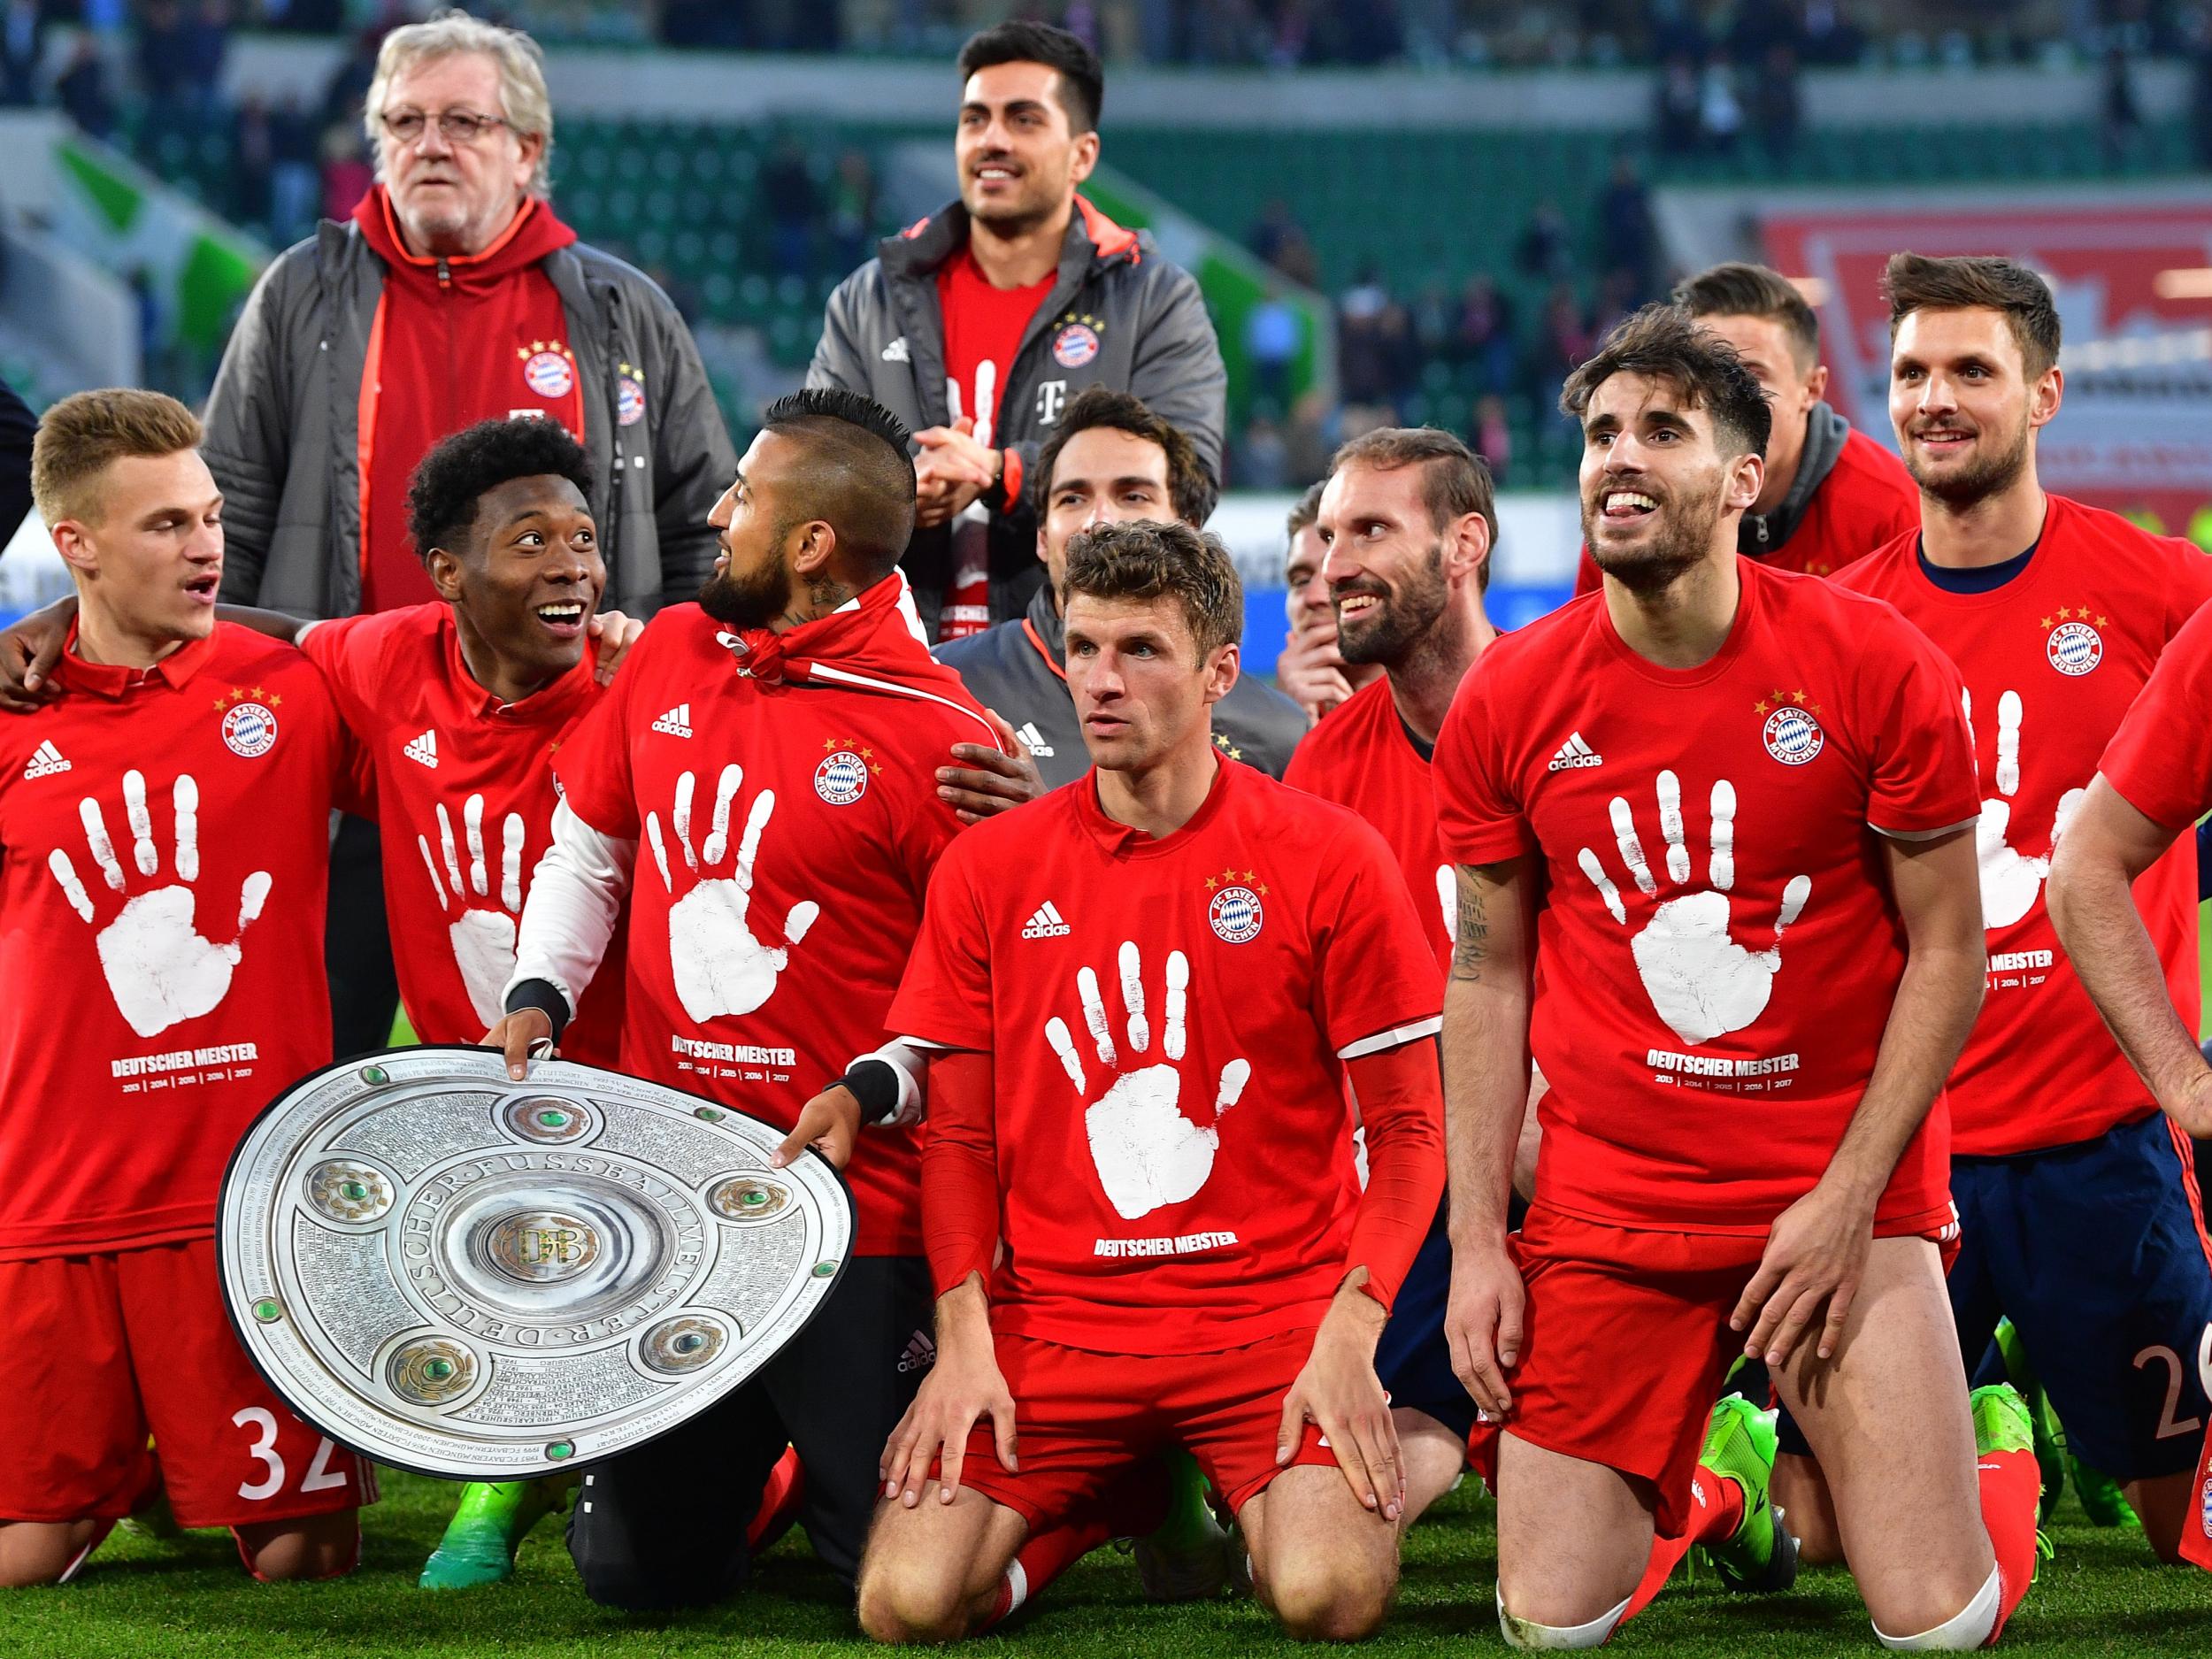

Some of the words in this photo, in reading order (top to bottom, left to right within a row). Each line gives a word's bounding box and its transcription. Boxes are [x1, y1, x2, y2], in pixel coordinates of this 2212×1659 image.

[2051, 633, 2062, 647] FC
[2060, 626, 2099, 646] BAYERN
[234, 706, 273, 726] BAYERN
[1767, 717, 1779, 734] FC
[1778, 710, 1819, 731] BAYERN
[651, 720, 693, 739] adidas
[403, 745, 439, 769] adidas
[837, 755, 864, 783] BAYERN
[1548, 754, 1602, 772] adidas
[24, 759, 72, 780] adidas
[1213, 896, 1225, 911] FC
[1225, 889, 1260, 914] BAYERN
[1021, 924, 1071, 940] adidas
[1991, 949, 2053, 972] MEISTER
[2001, 979, 2019, 987] 2016
[2029, 975, 2046, 985] 2017
[111, 1051, 195, 1078] DEUTSCHER
[194, 1042, 258, 1066] MEISTER
[672, 1034, 734, 1062] DETSCHER
[735, 1045, 796, 1066] MEISTER
[1647, 1048, 1733, 1077] DEUTSCHER
[1735, 1053, 1800, 1077] MEISTER
[122, 1082, 140, 1093] 2013
[150, 1079, 168, 1089] 2014
[178, 1075, 196, 1086] 2015
[206, 1072, 225, 1081] 2016
[234, 1068, 253, 1078] 2017
[719, 1068, 737, 1078] 2015
[744, 1071, 763, 1080] 2016
[772, 1073, 789, 1082] 2017
[1655, 1074, 1674, 1084] 2013
[1684, 1079, 1702, 1088] 2014
[1774, 1079, 1793, 1088] 2017
[475, 1153, 701, 1342] FUSSBALLMEISTER
[1094, 1238, 1175, 1257] DEUTSCHER
[1174, 1231, 1239, 1255] MEISTER
[404, 1170, 548, 1347] DEUTSCHER
[897, 1351, 936, 1372] adida
[231, 1406, 347, 1501] 32
